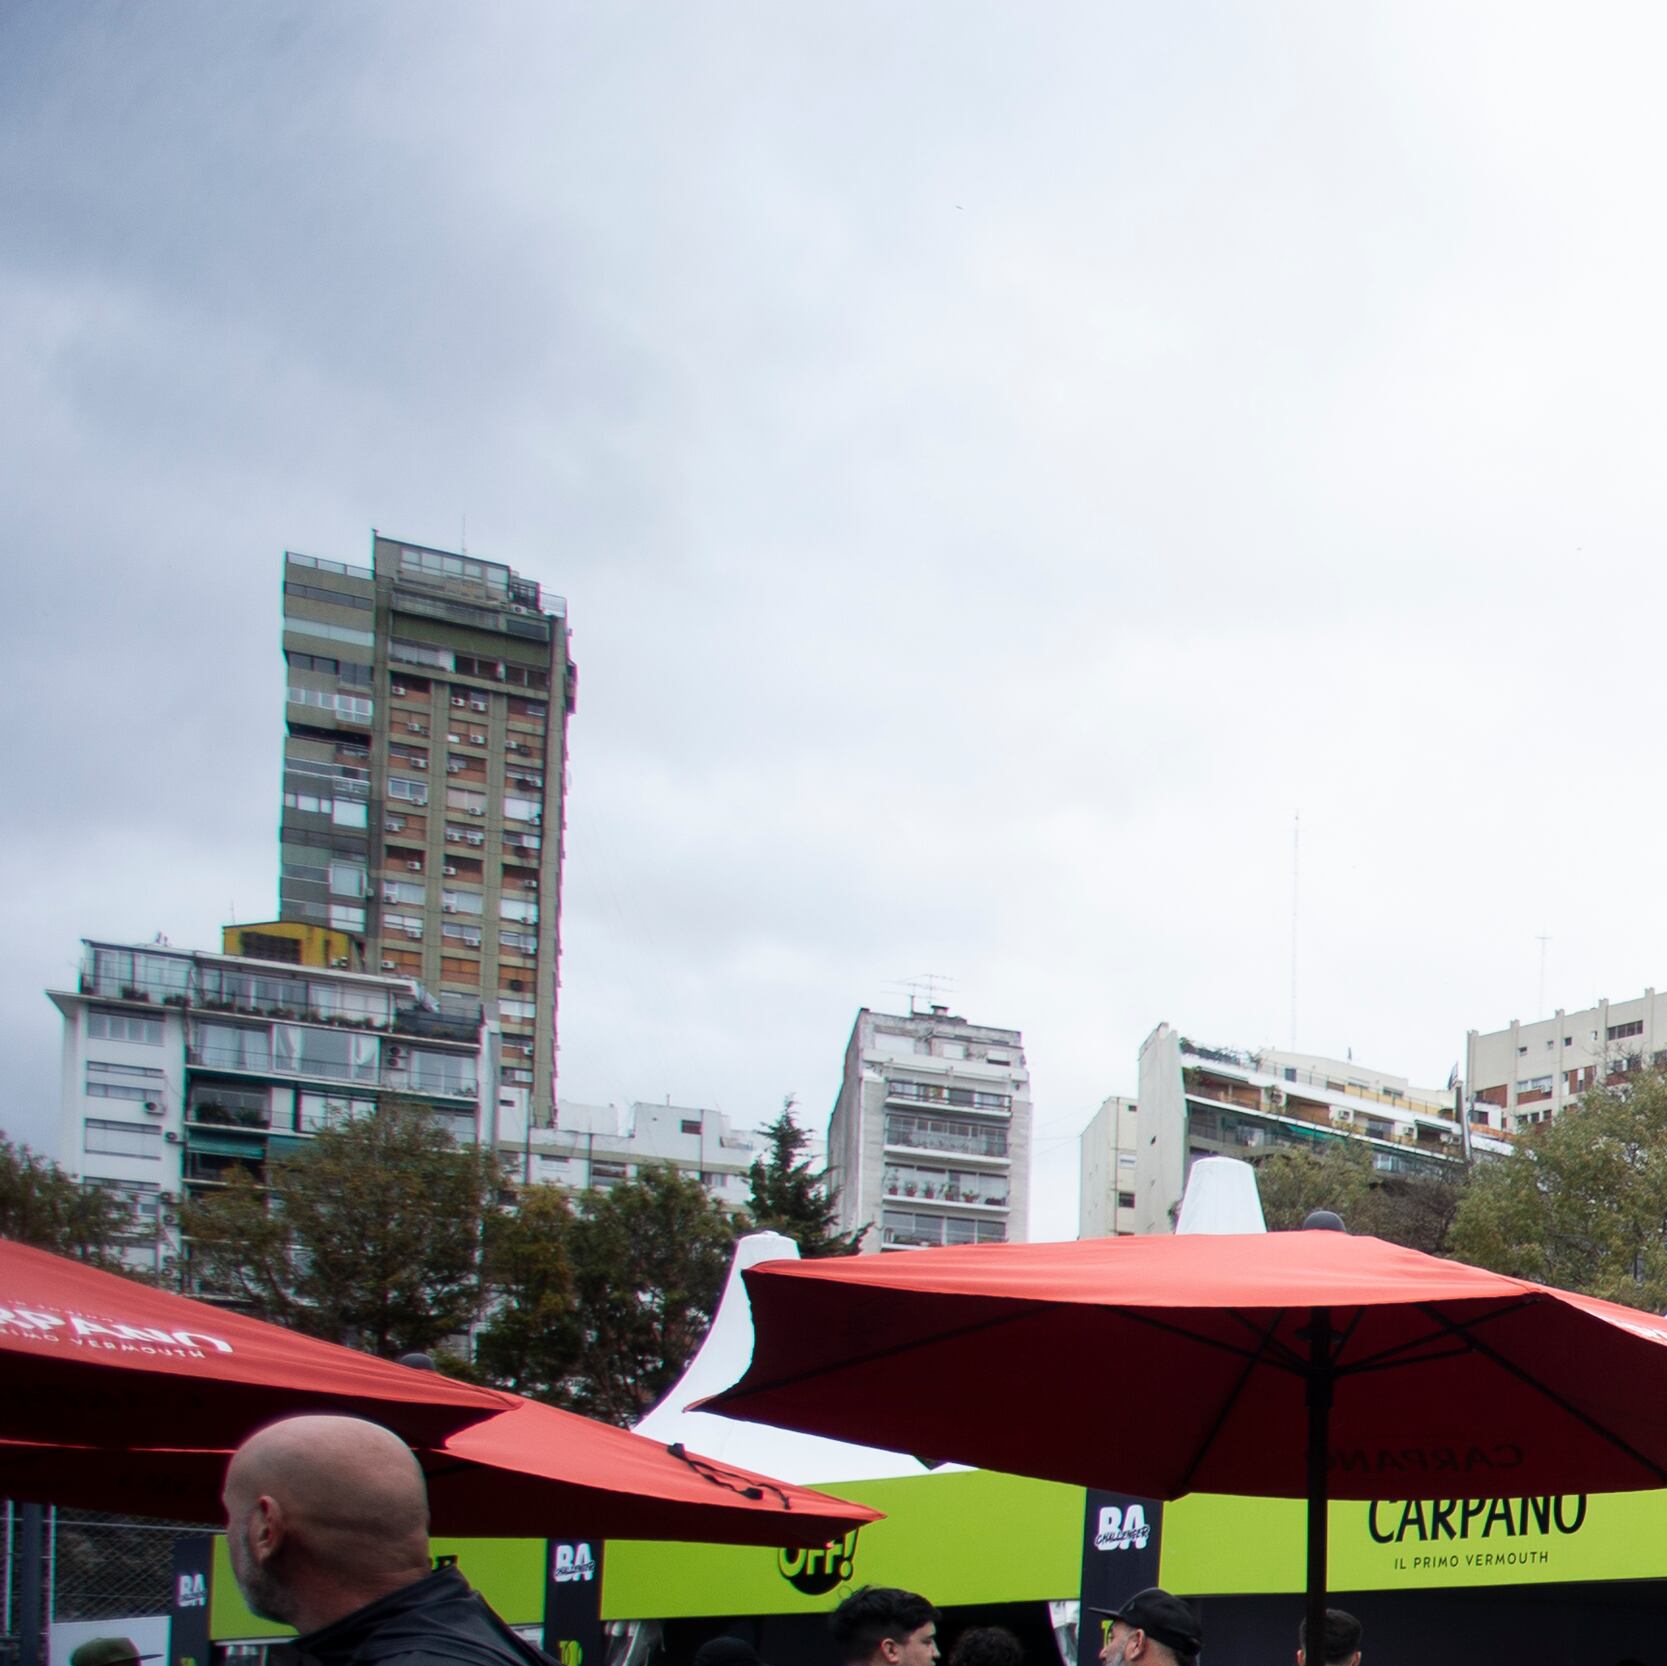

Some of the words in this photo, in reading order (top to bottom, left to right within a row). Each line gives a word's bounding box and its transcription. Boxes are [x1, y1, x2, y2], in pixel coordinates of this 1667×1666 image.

[70, 1338, 206, 1359] VERMOUTH
[1098, 1504, 1148, 1550] BA
[1369, 1494, 1587, 1543] CARPANO
[555, 1543, 594, 1581] BA
[1394, 1559, 1407, 1569] IL
[1414, 1555, 1459, 1568] PRIMO
[1466, 1551, 1549, 1566] VERMOUTH
